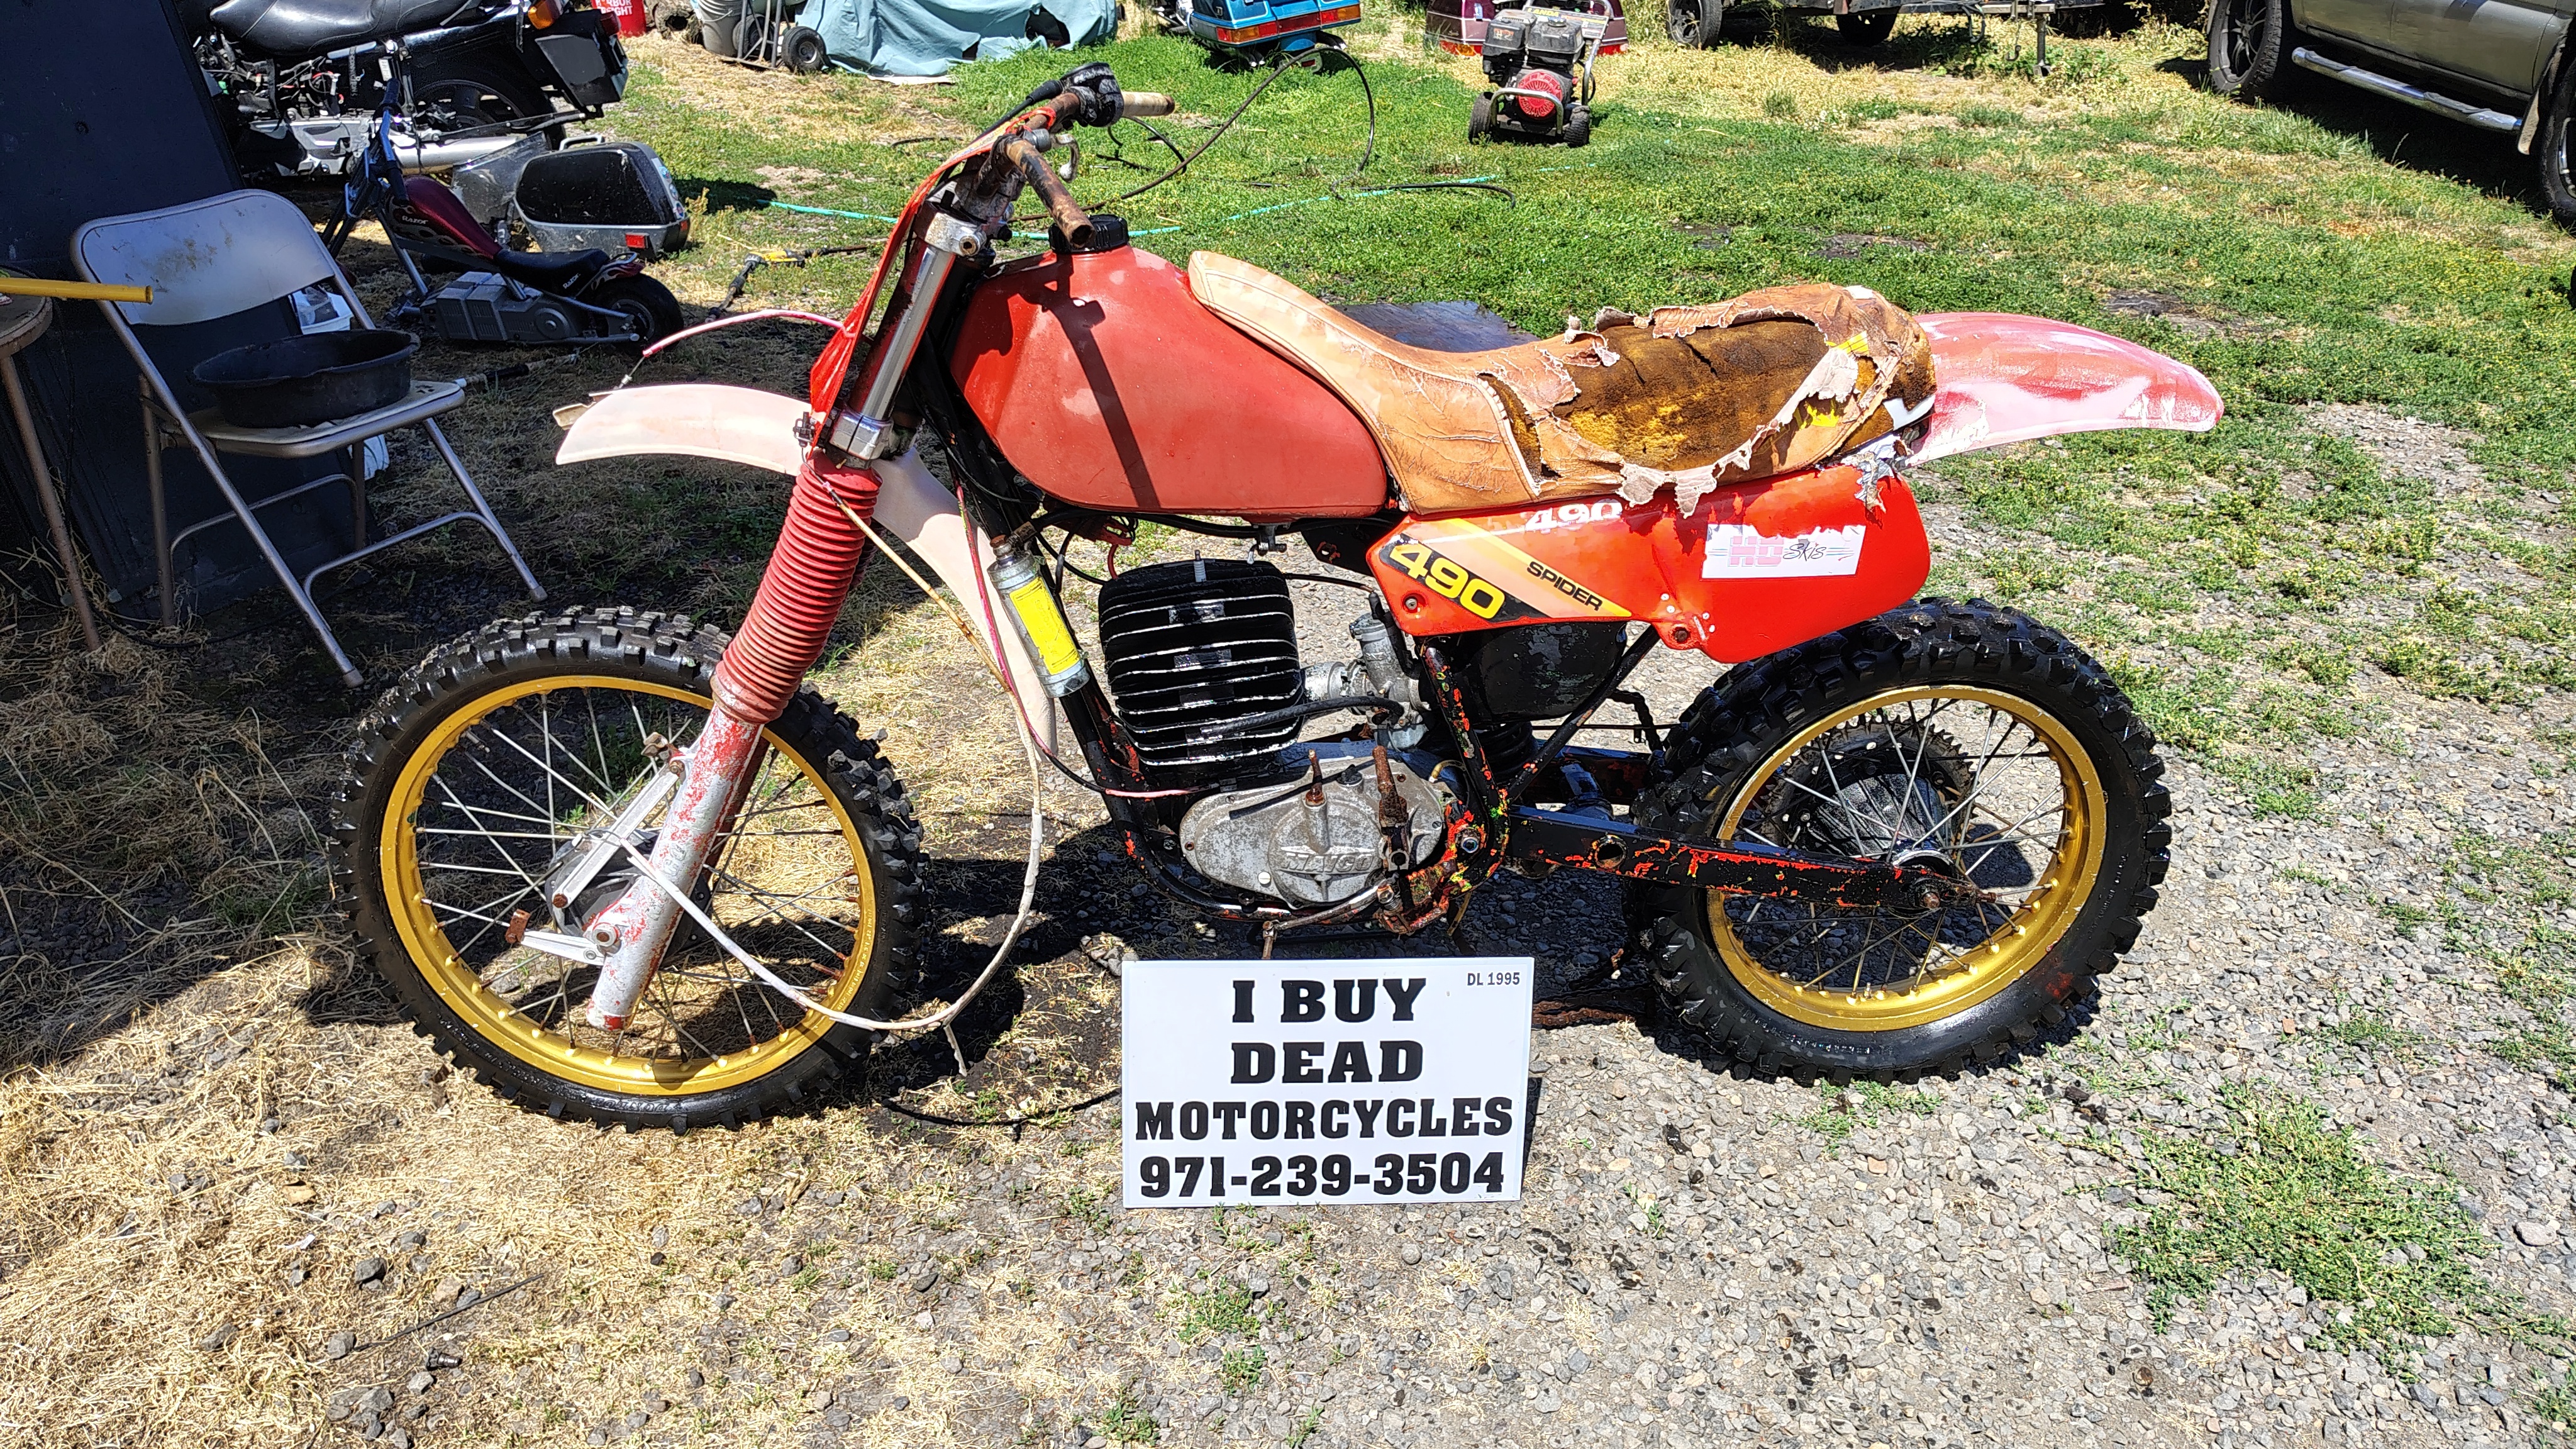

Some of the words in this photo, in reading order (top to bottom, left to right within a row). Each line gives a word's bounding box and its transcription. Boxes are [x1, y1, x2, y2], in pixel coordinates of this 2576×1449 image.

[1526, 8, 1560, 18] LANDA
[1525, 498, 1623, 533] 490
[1389, 543, 1505, 619] 490
[1526, 561, 1603, 611] SPIDER
[1280, 852, 1374, 872] MAICO
[1233, 980, 1255, 1023] I
[1280, 977, 1426, 1023] BUY
[1467, 972, 1484, 985] DL
[1487, 972, 1520, 985] 1995
[1231, 1040, 1423, 1084] DEAD
[1136, 1097, 1513, 1140] MOTORCYCLES
[1140, 1152, 1504, 1198] 971-239-3504
